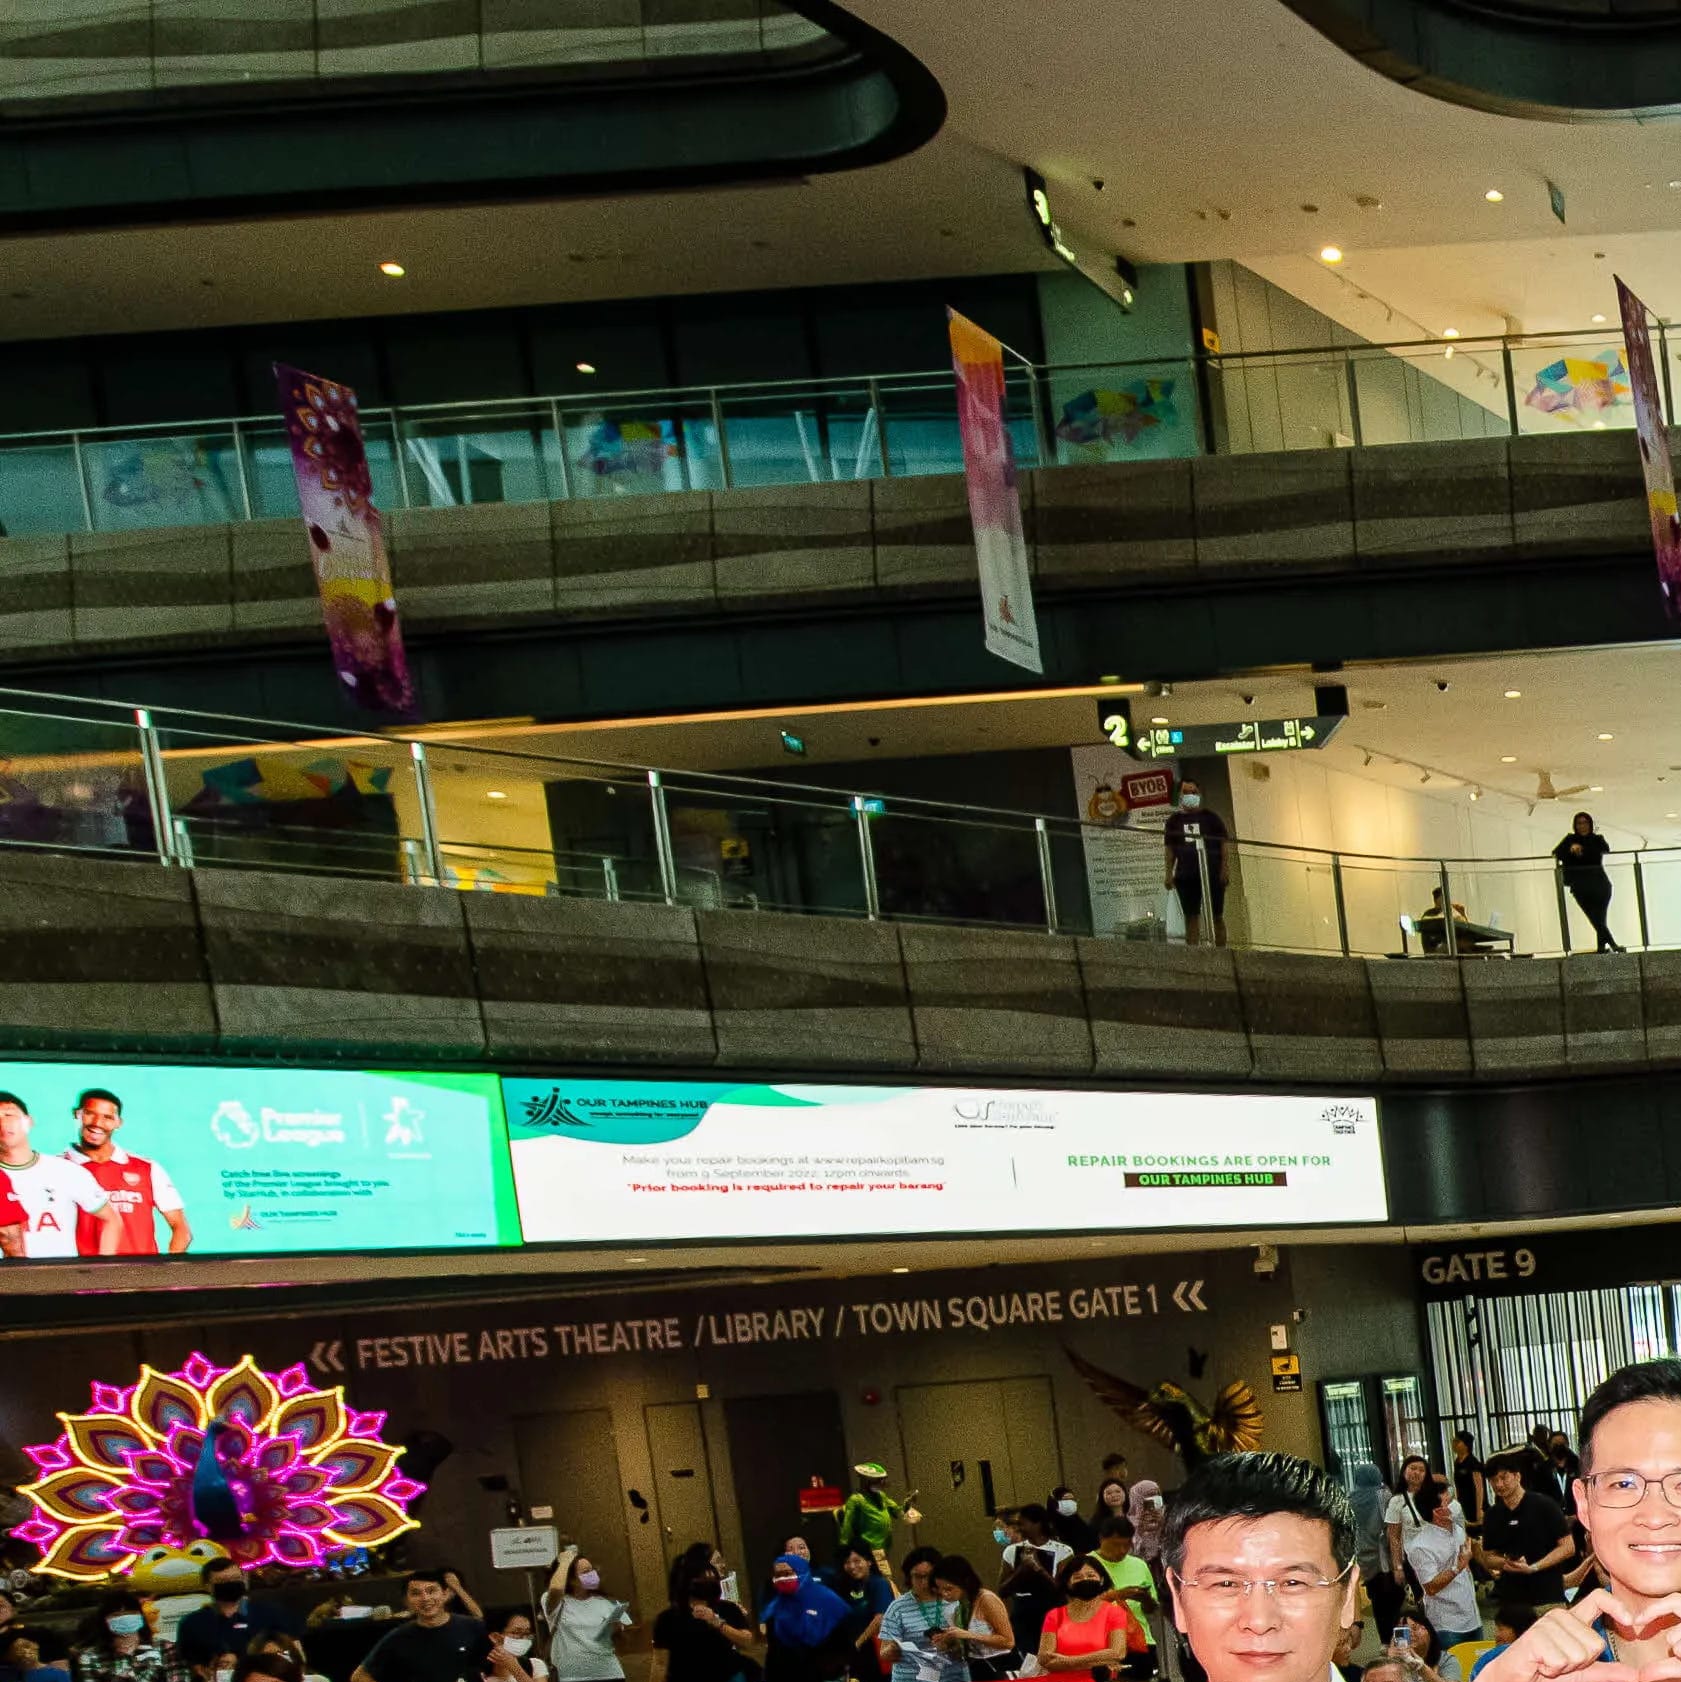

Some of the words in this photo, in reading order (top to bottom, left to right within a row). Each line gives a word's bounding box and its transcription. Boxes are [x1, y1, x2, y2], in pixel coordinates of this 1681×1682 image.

[1104, 715, 1129, 746] 2
[1261, 738, 1288, 750] Lobby
[1130, 778, 1167, 797] BYOB
[576, 1098, 606, 1107] OUR
[609, 1098, 677, 1109] TAMPINES
[679, 1100, 709, 1109] HUB
[623, 1155, 659, 1165] Make
[663, 1156, 693, 1168] your
[696, 1155, 732, 1167] repair
[737, 1154, 795, 1166] bookings
[798, 1155, 809, 1165] at
[1068, 1155, 1127, 1167] REPAIR
[1133, 1155, 1219, 1167] BOOKINGS
[1223, 1156, 1257, 1167] ARE
[1260, 1156, 1297, 1166] OPEN
[1302, 1156, 1331, 1166] FOR
[666, 1169, 698, 1178] from
[712, 1169, 786, 1181] September
[1139, 1174, 1170, 1185] OUR
[1172, 1174, 1242, 1185] TAMPINES
[1245, 1174, 1274, 1185] HUB
[671, 1182, 728, 1193] booking
[732, 1182, 743, 1191] is
[747, 1182, 805, 1194] required
[809, 1182, 822, 1191] to
[826, 1182, 864, 1193] repair
[868, 1182, 895, 1192] your
[1422, 1251, 1509, 1285] GATE
[1515, 1249, 1537, 1278] 9
[357, 1332, 471, 1370] FESTIVE
[478, 1327, 549, 1361] ARTS
[554, 1318, 682, 1356] THEATRE
[710, 1307, 825, 1345] LIBRARY
[835, 1306, 844, 1337] /
[852, 1299, 942, 1335] TOWN
[950, 1290, 1063, 1331] SQUARE
[1069, 1285, 1142, 1319] GATE
[1147, 1285, 1159, 1313] 1
